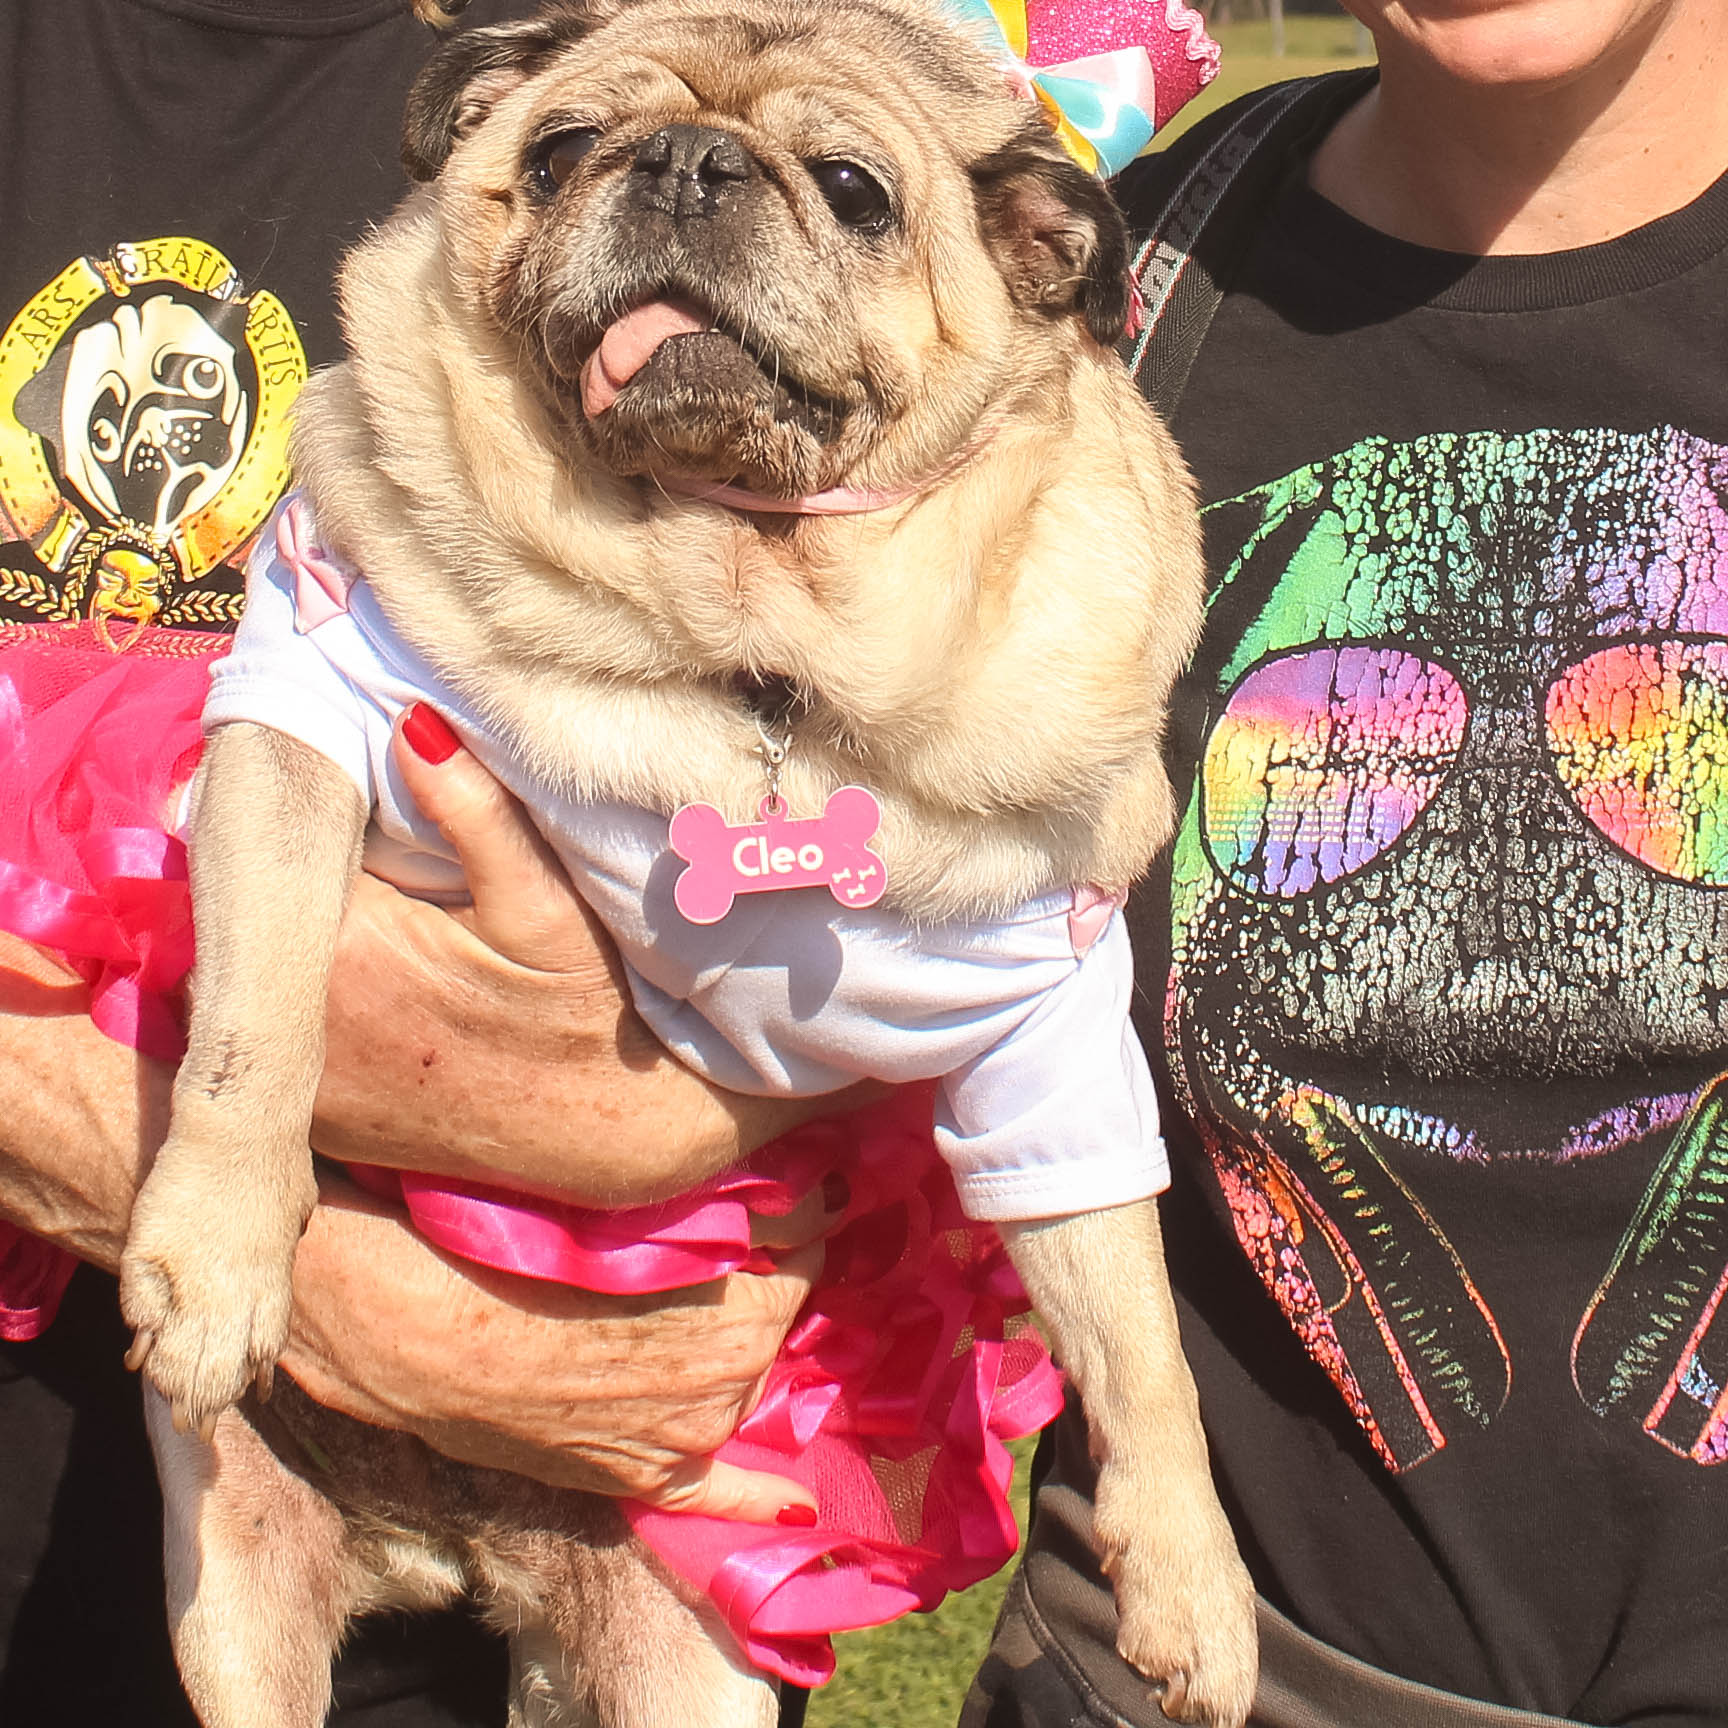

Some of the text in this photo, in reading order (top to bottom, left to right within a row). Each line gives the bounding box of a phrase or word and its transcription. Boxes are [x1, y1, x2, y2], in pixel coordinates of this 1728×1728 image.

[23, 288, 75, 350] ARS
[247, 302, 296, 385] ARTIS
[733, 836, 824, 877] Cleo
